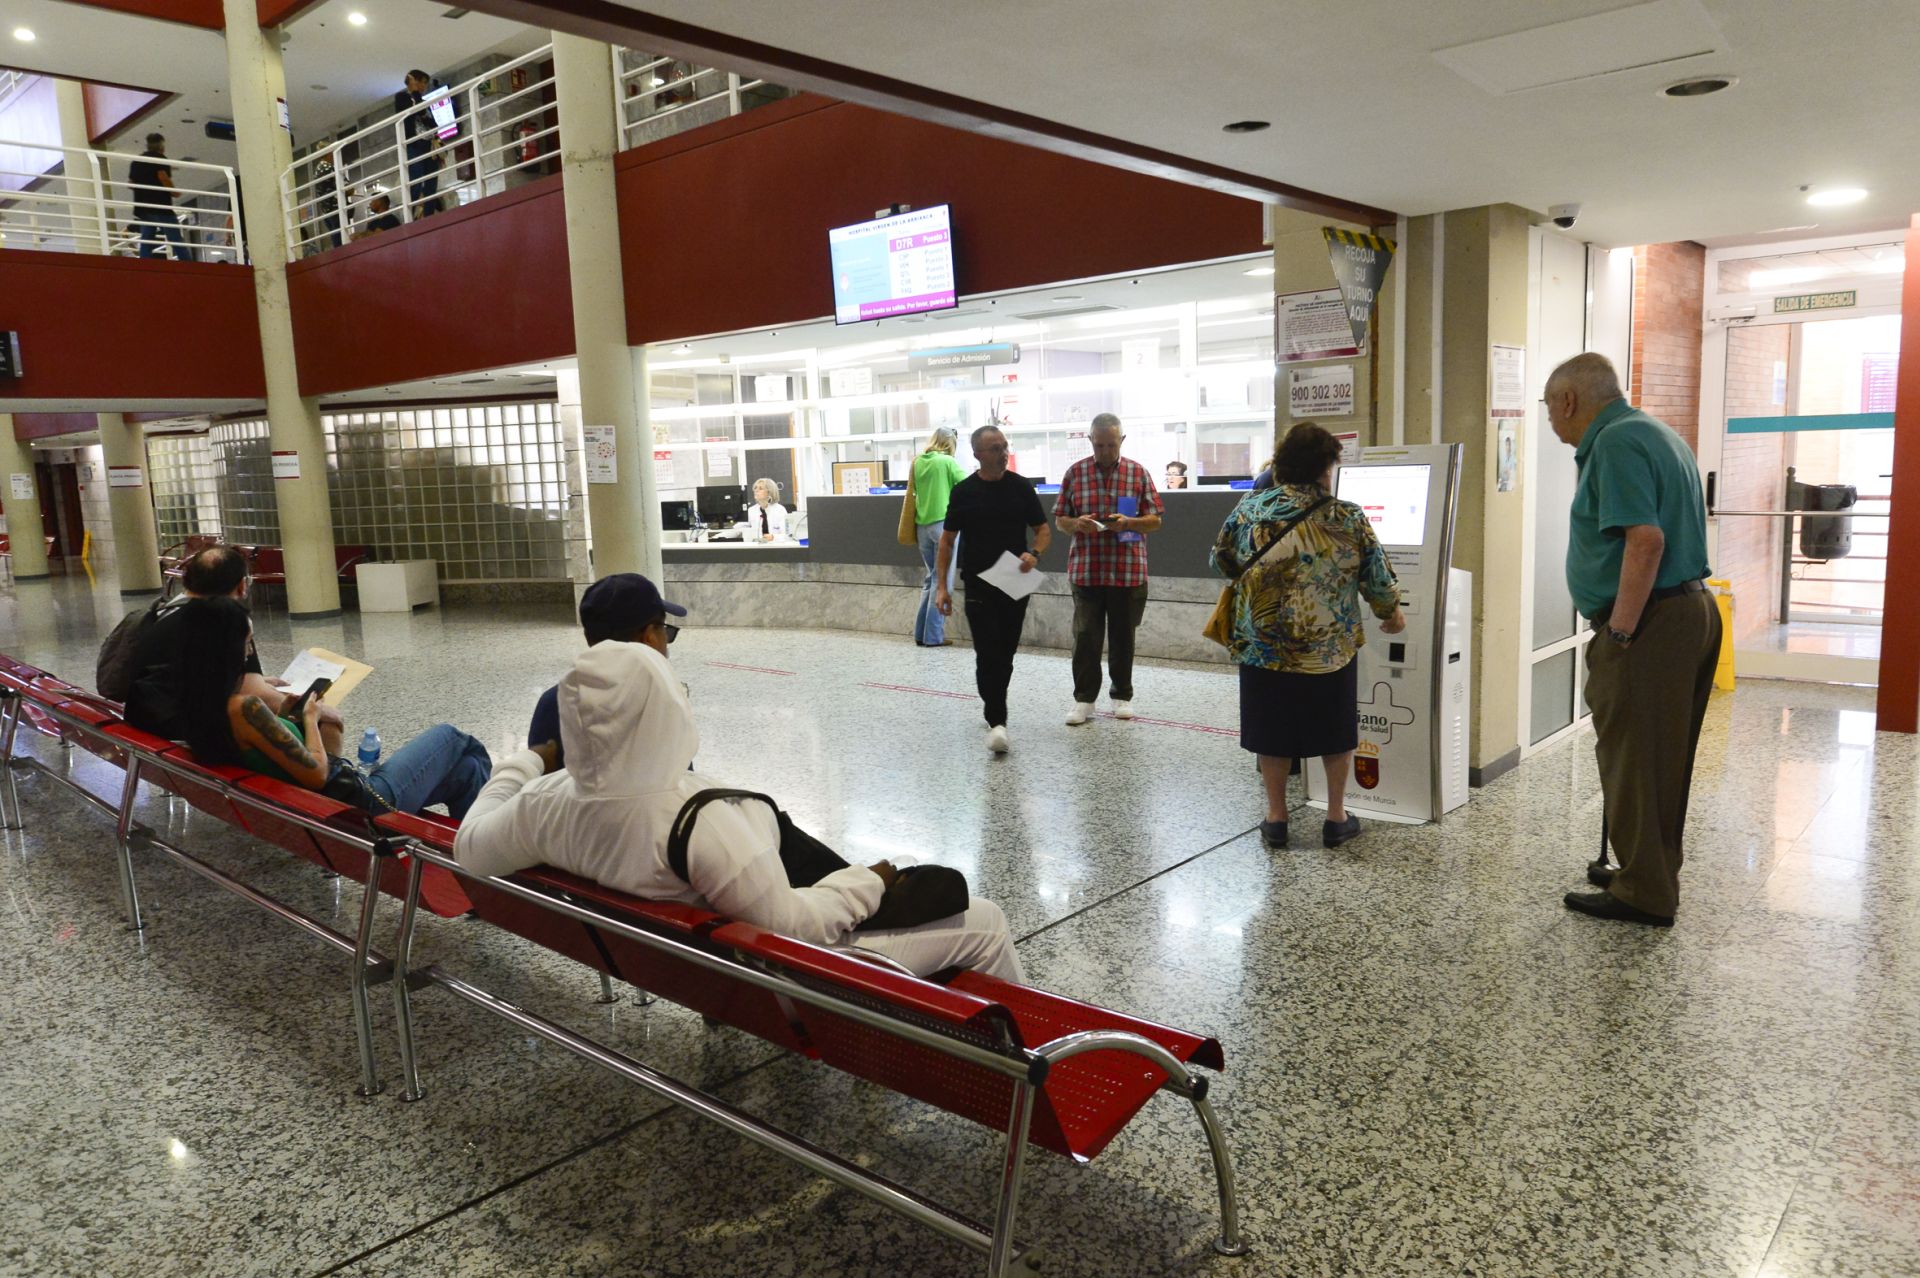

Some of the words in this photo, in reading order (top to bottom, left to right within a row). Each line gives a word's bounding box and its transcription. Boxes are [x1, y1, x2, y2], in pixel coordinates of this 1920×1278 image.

[923, 233, 943, 244] Puesto
[1345, 244, 1376, 264] RECOJA
[1355, 267, 1366, 282] SU
[1347, 286, 1374, 303] TURNO
[1775, 297, 1800, 312] SALIDA
[1800, 296, 1810, 310] DE
[1811, 292, 1853, 308] EMERGENCIA
[928, 356, 951, 366] Servicio
[952, 354, 960, 363] de
[961, 352, 991, 363] Admisión
[1137, 352, 1144, 365] 2
[1291, 386, 1309, 401] 900
[1312, 385, 1330, 400] 302
[1333, 383, 1351, 398] 302
[1360, 724, 1369, 732] de
[1370, 725, 1389, 734] Salud
[1363, 794, 1371, 802] de
[1373, 795, 1397, 805] Murcia
